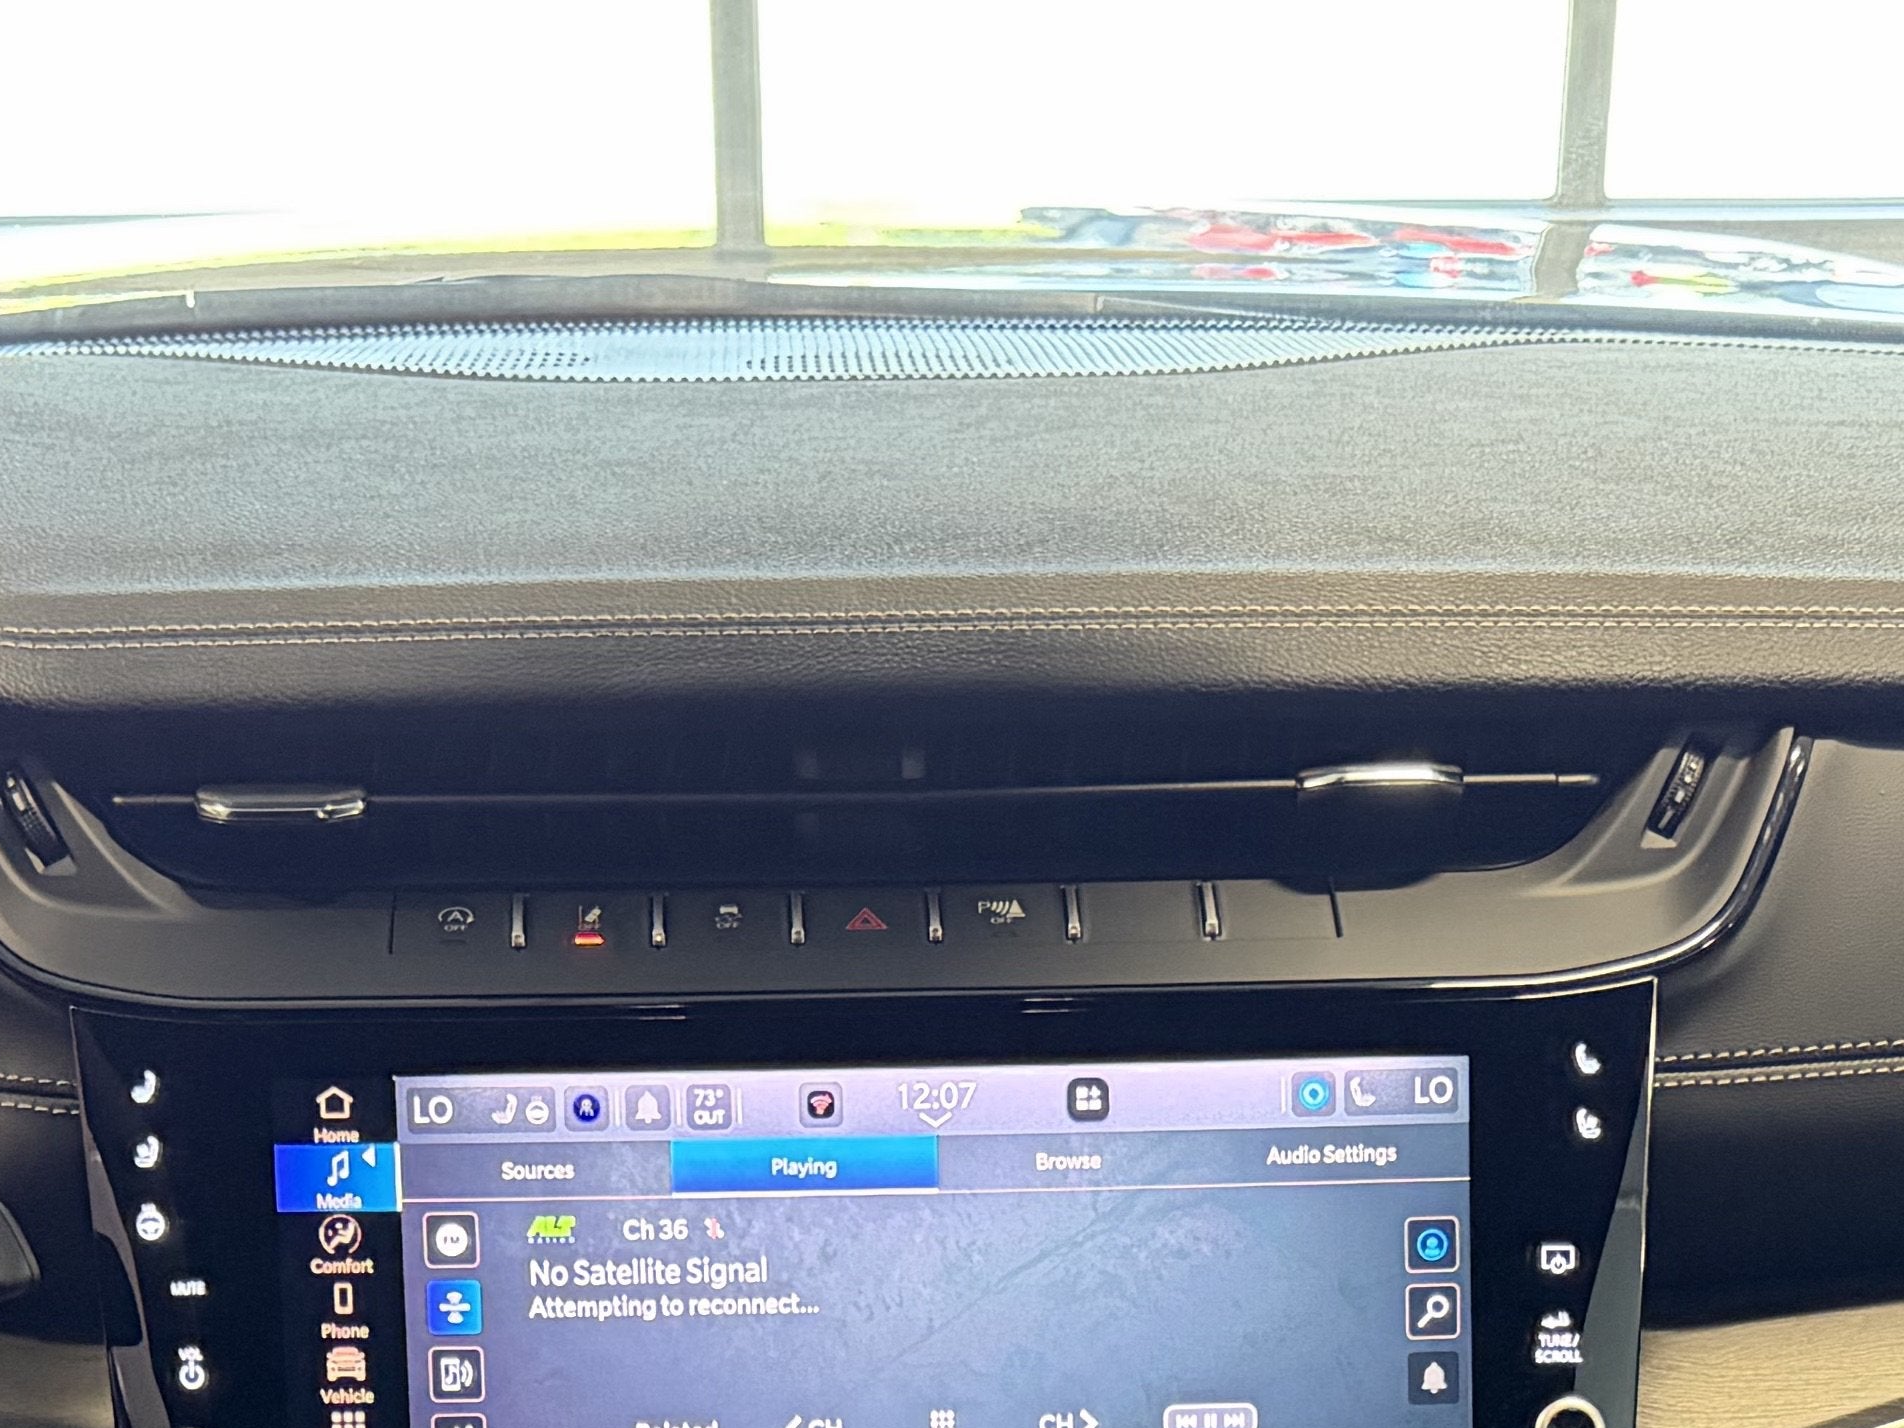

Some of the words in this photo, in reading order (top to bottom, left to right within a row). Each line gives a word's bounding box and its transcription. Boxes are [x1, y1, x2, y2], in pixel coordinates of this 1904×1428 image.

[898, 1081, 977, 1110] 12:07
[1414, 1075, 1454, 1104] LO
[413, 1094, 454, 1124] LO
[693, 1109, 726, 1126] OUT
[313, 1127, 360, 1144] Home
[1035, 1152, 1102, 1171] Browse
[1266, 1145, 1322, 1165] Audio
[1323, 1143, 1398, 1167] Settings
[501, 1161, 576, 1181] Sources
[770, 1157, 838, 1180] Playing
[315, 1193, 363, 1210] Media
[622, 1218, 655, 1240] Ch
[658, 1218, 689, 1240] 36
[309, 1257, 375, 1275] Comfort
[529, 1259, 569, 1287] No
[573, 1256, 682, 1287] Satellite
[686, 1255, 768, 1290] Signal
[170, 1280, 207, 1296] MUTE
[528, 1294, 657, 1321] Attempting
[660, 1294, 684, 1318] to
[688, 1292, 820, 1317] reconnect...
[320, 1322, 370, 1339] Phone
[1535, 1349, 1584, 1364] SCROLL
[319, 1388, 375, 1405] Vehicle
